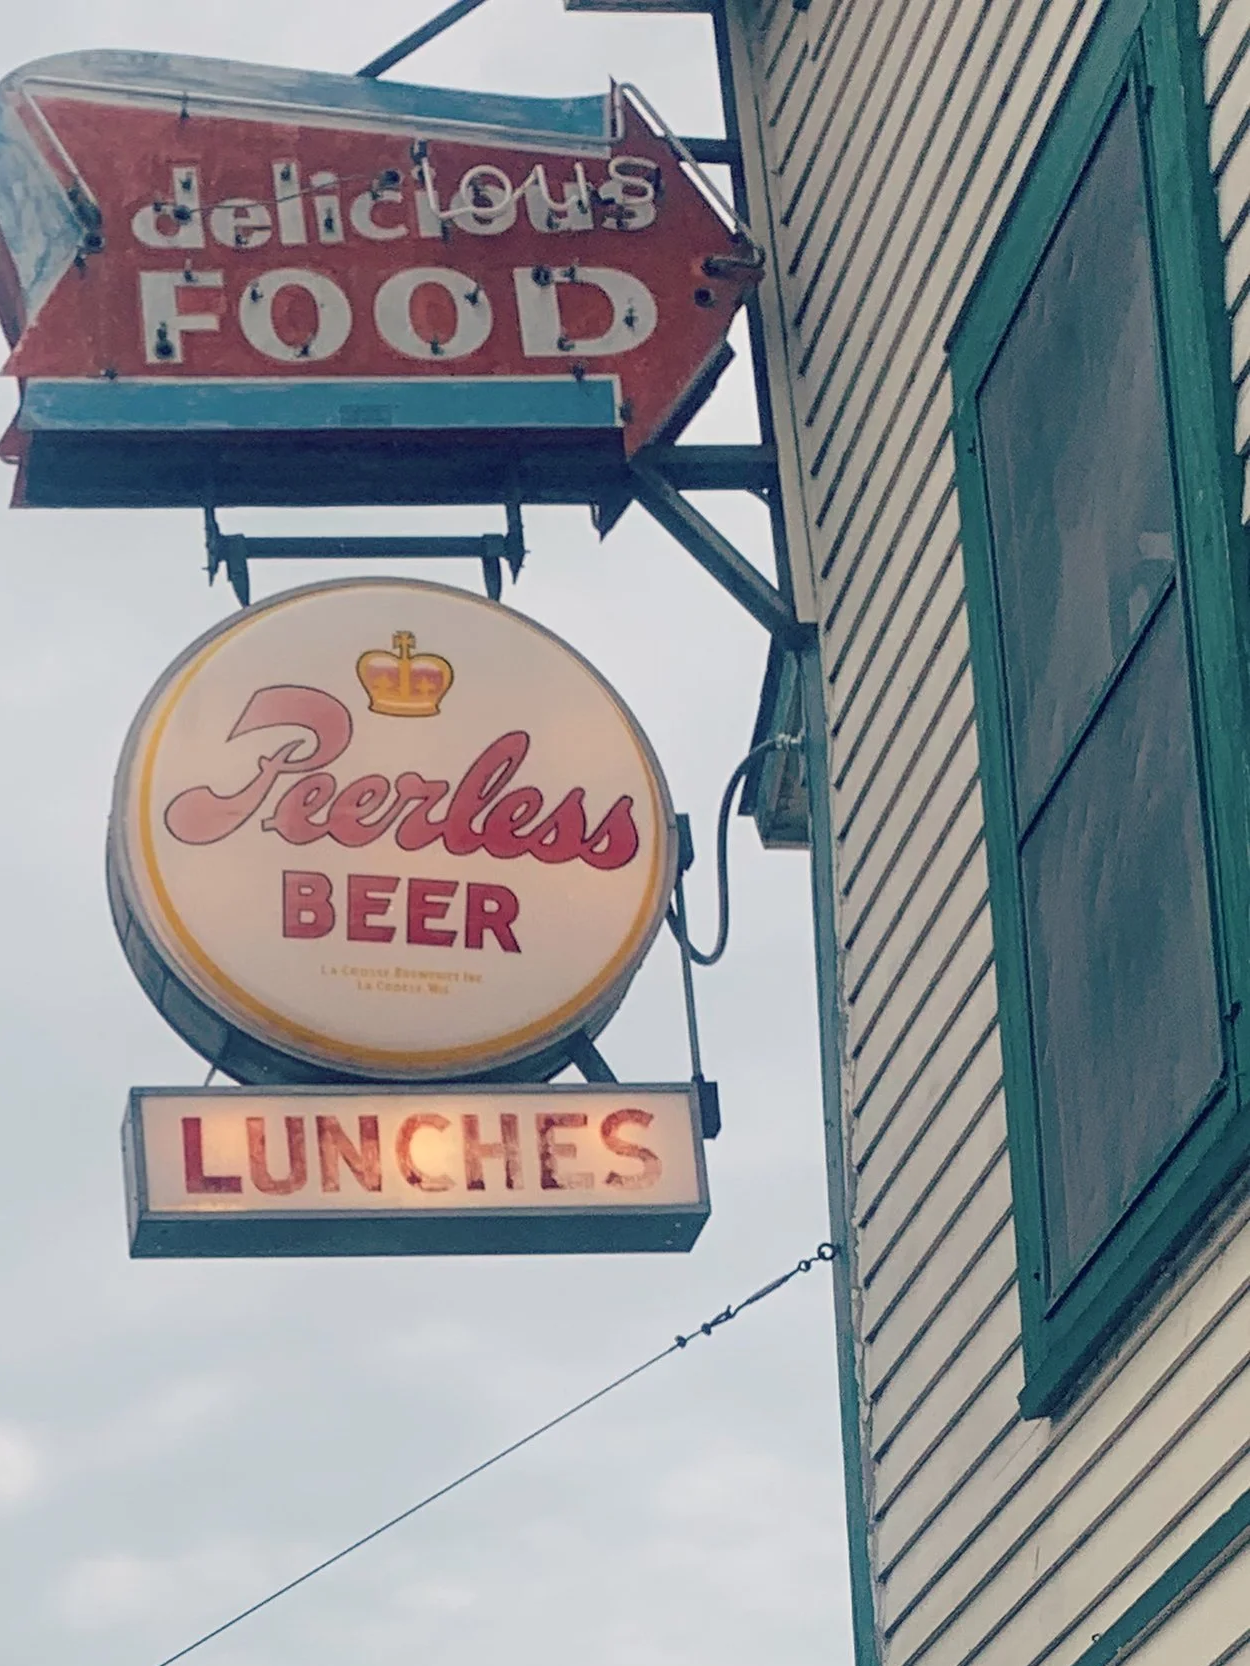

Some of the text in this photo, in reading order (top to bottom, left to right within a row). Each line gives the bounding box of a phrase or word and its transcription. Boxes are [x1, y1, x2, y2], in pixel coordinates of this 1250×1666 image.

[132, 158, 660, 250] delicious
[139, 266, 659, 366] FOOD
[163, 684, 640, 871] Peerless
[280, 868, 522, 954] BEER
[180, 1107, 663, 1195] LUNCHES
